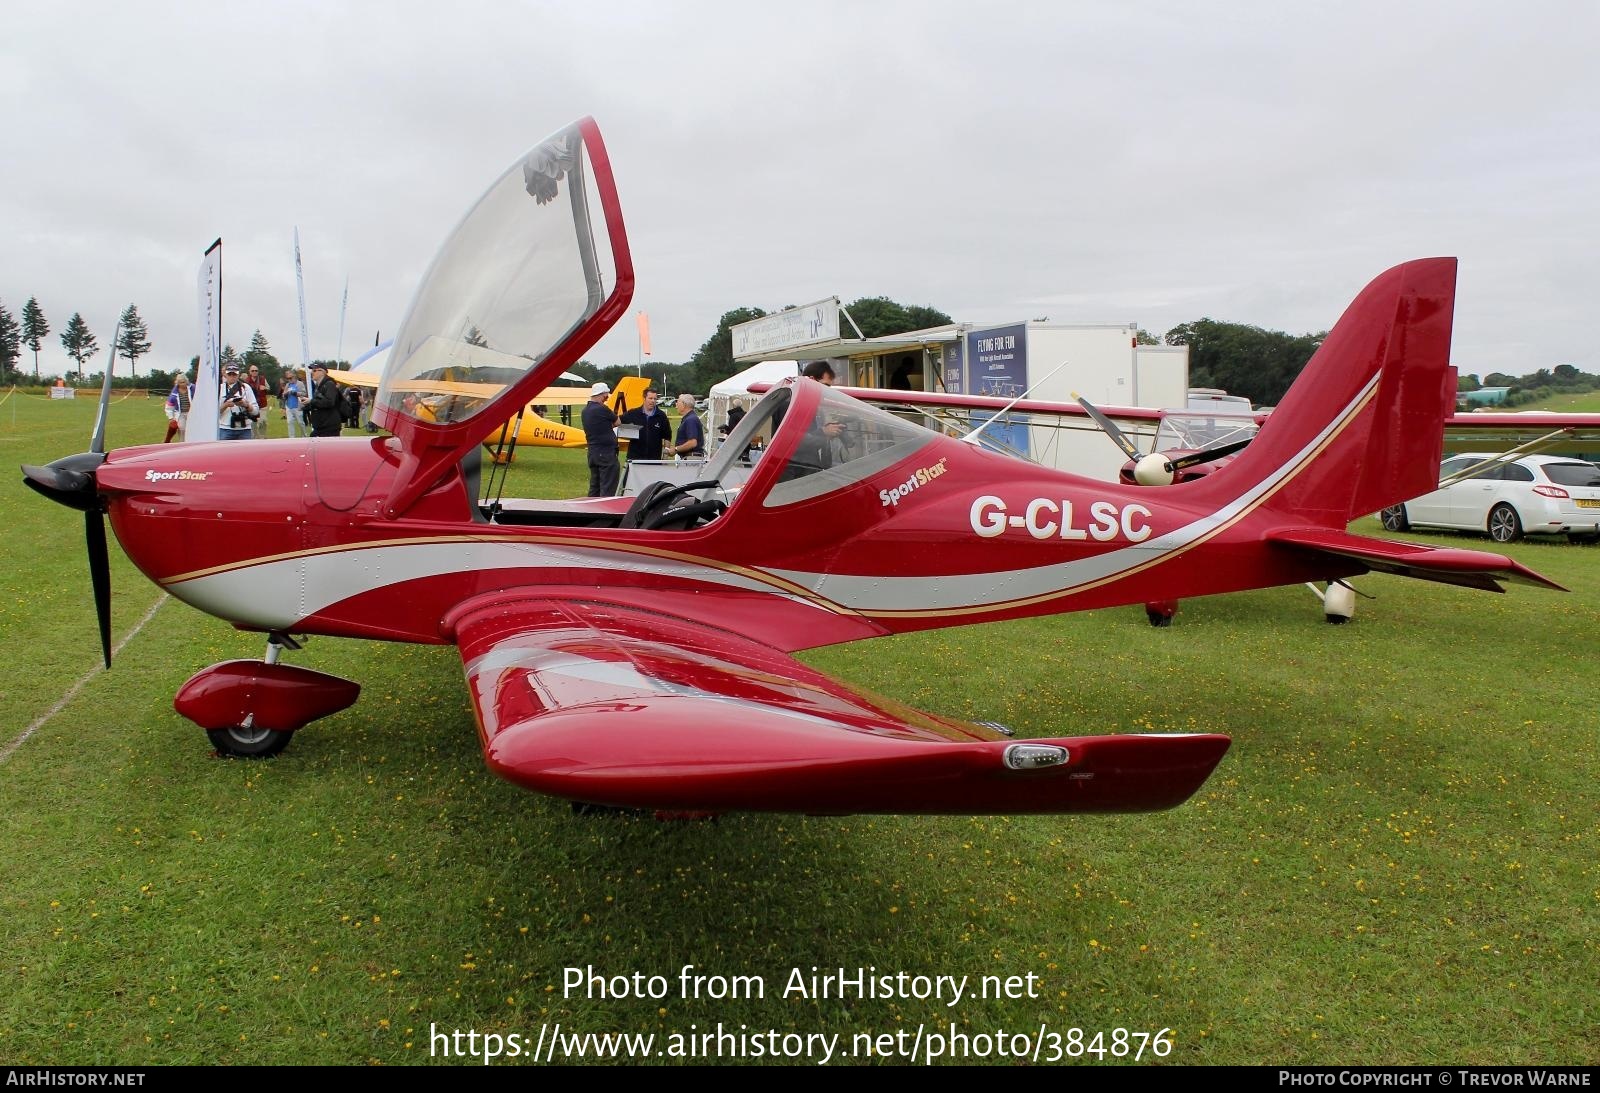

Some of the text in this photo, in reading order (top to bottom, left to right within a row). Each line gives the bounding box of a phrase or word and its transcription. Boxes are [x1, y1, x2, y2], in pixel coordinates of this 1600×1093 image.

[978, 336, 1015, 353] FLYING FOR FUN
[970, 495, 1152, 543] G-CLSC
